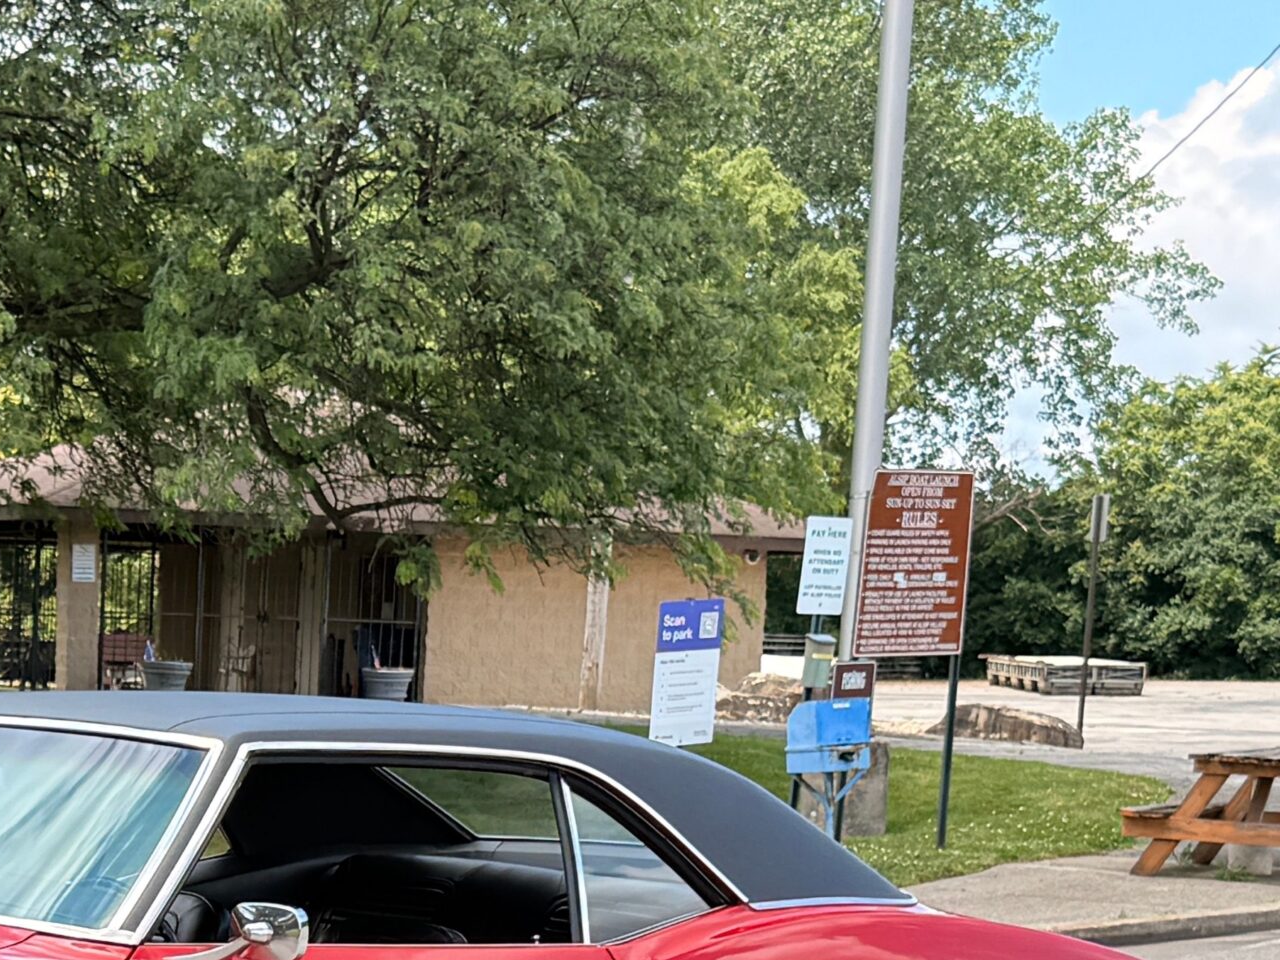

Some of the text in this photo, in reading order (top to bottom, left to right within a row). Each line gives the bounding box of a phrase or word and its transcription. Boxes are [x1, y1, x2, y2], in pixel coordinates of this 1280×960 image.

[901, 486, 943, 497] OPEN FROM
[914, 498, 924, 508] TO
[901, 511, 937, 527] RULES
[811, 529, 847, 539] PAY HERE
[663, 614, 685, 627] Scan
[662, 627, 693, 643] to park
